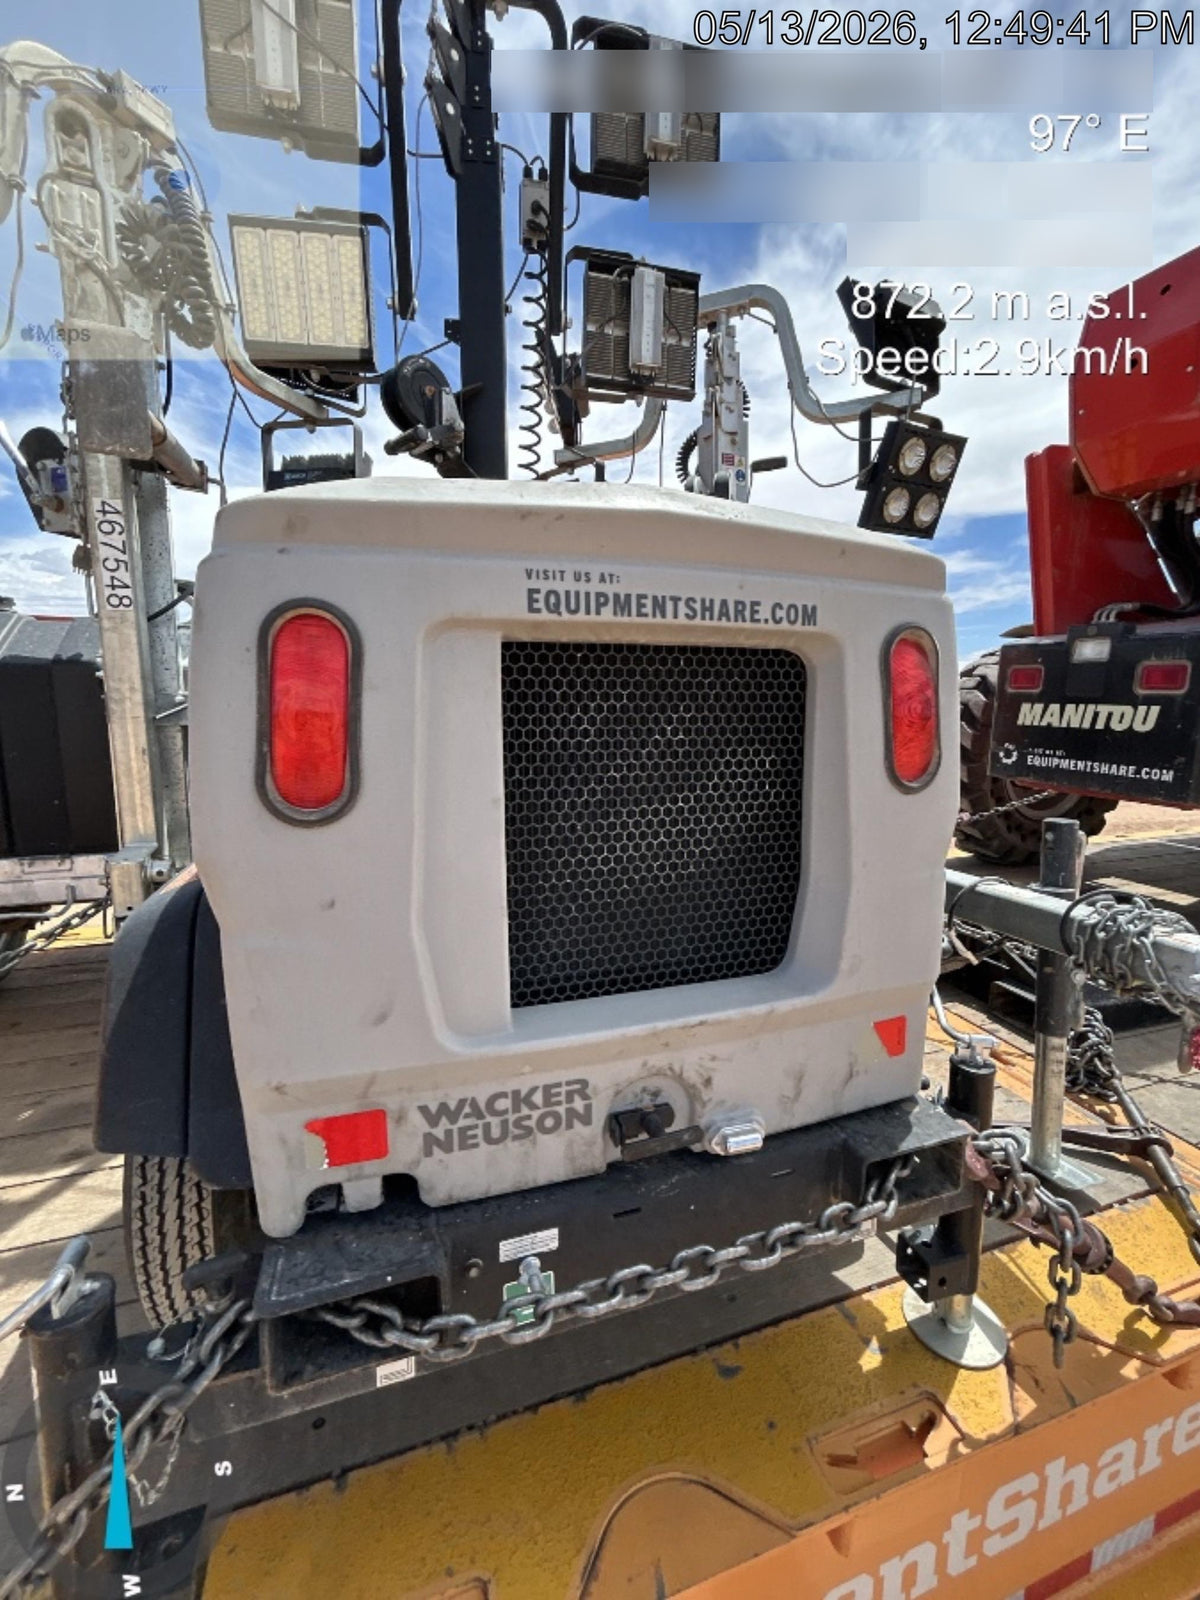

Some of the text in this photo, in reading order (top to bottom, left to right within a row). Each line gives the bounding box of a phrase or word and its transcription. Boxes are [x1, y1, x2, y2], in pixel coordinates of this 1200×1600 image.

[95, 500, 133, 609] 467548
[525, 568, 621, 584] VISIT US AT:
[526, 587, 818, 627] EQUIPMENTSHARE.COM
[1016, 702, 1162, 733] MANITOU
[1026, 755, 1175, 782] EQUIPMENTSHARE.COM
[417, 1078, 592, 1129] WACKER
[423, 1102, 593, 1158] NEUSON
